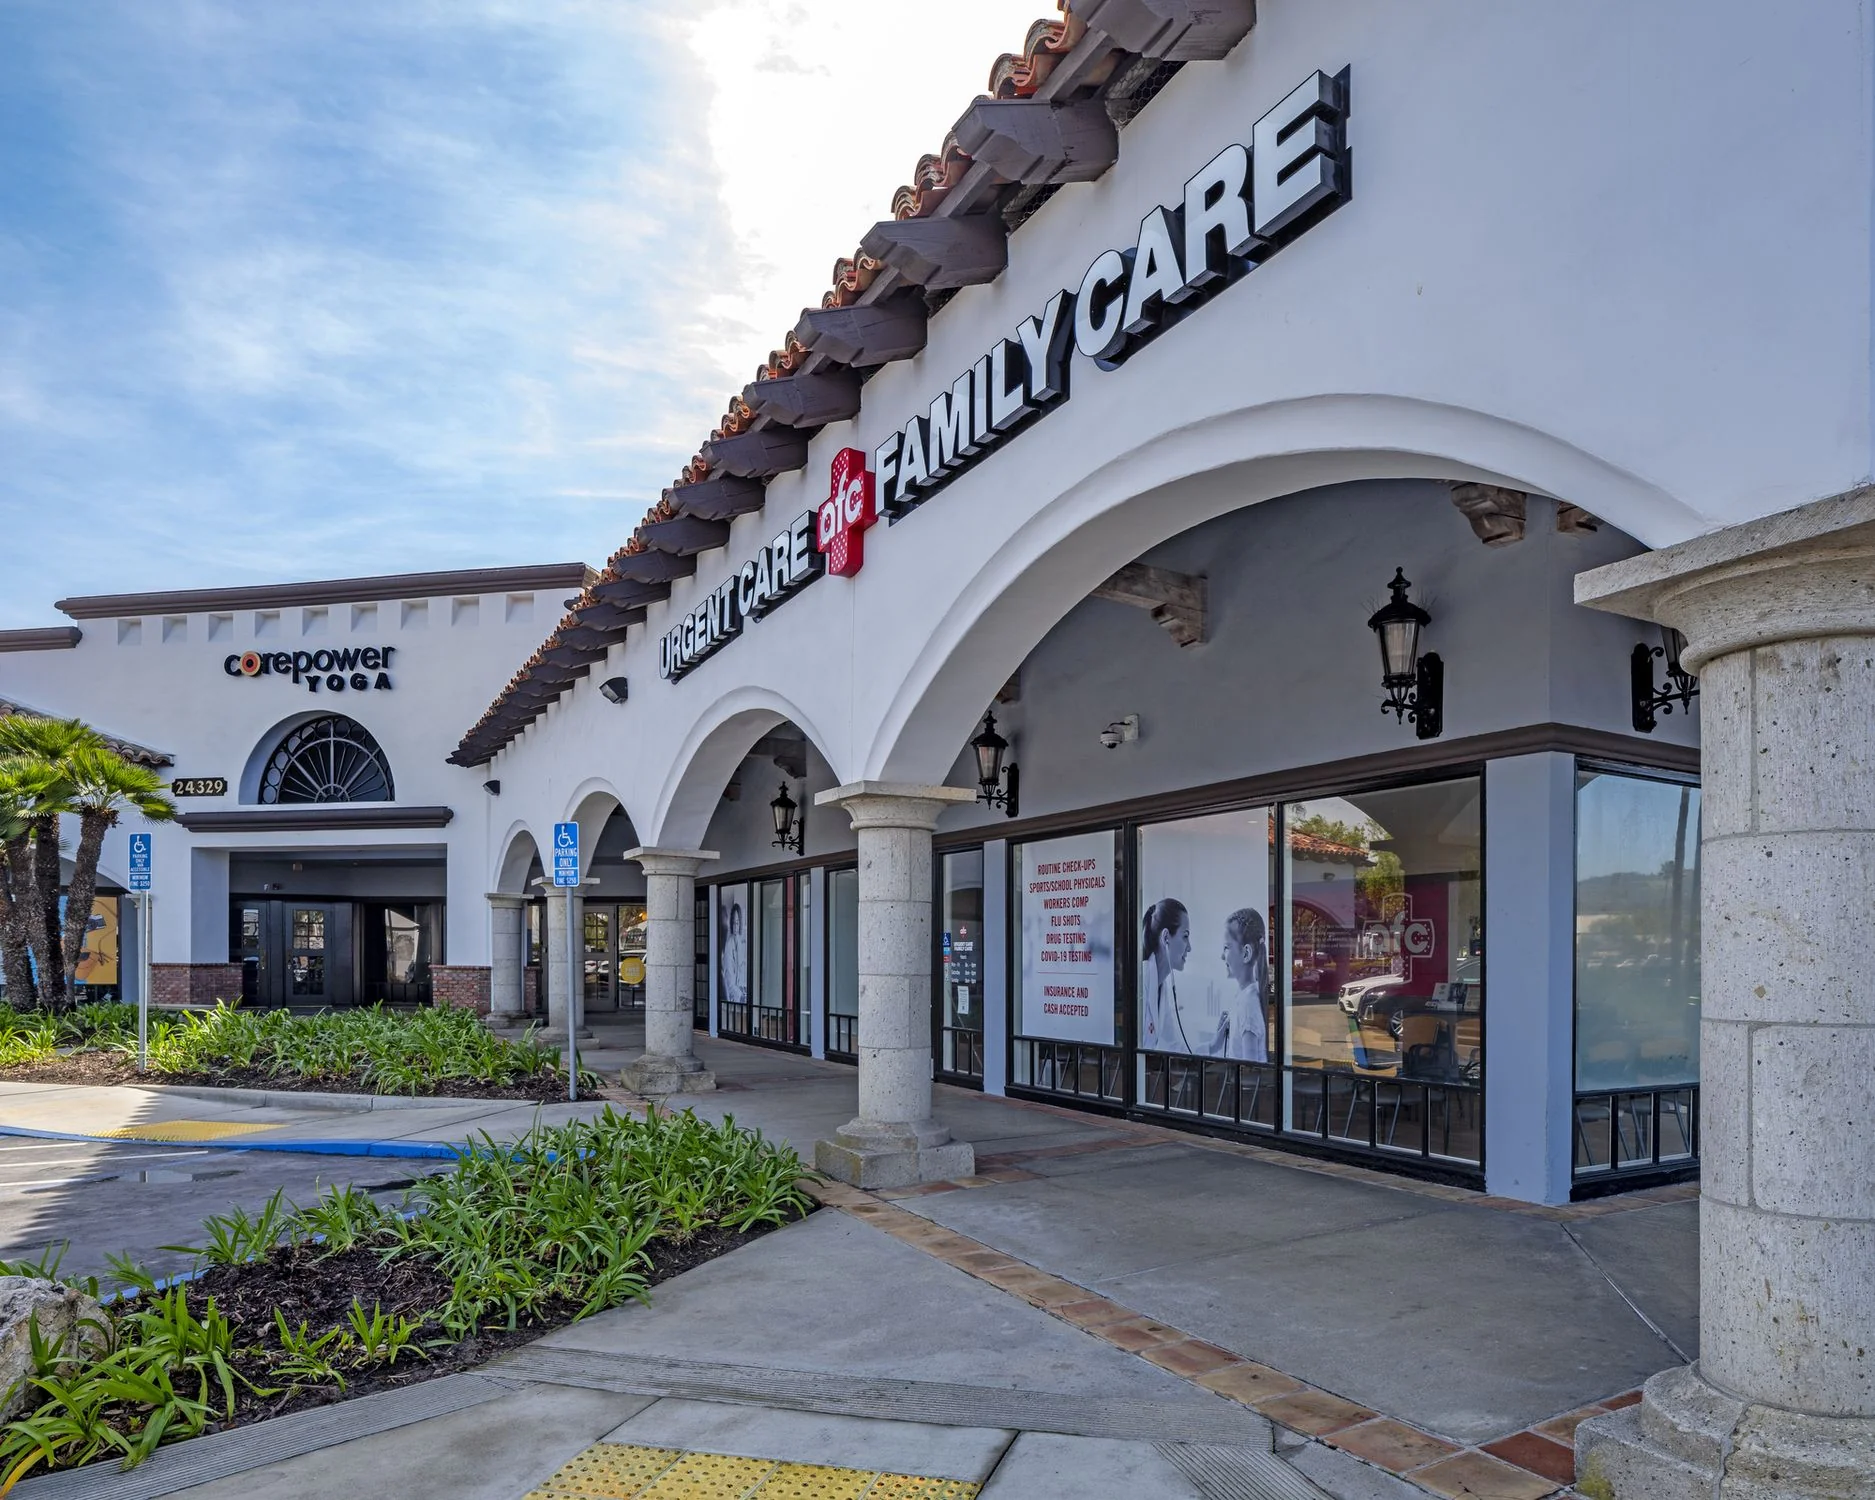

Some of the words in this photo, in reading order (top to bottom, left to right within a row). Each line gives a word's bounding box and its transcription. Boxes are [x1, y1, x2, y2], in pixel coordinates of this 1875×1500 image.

[874, 290, 1069, 519] FAMILY
[1074, 66, 1346, 366] CARE
[820, 469, 862, 545] afc
[659, 575, 739, 681] URGENT
[738, 510, 817, 617] CARE
[224, 646, 396, 684] corepower
[304, 672, 392, 692] YOGA
[175, 779, 223, 795] 24329
[555, 848, 577, 856] PARKING
[560, 858, 572, 866] ONLY
[1037, 862, 1061, 876] ROUTINE
[1062, 859, 1096, 873] CHECK-UPS
[1029, 879, 1072, 893] SPORTS/SCHOOL
[1073, 876, 1106, 890] PHYSICALS
[1043, 897, 1070, 910] WORKERS
[1071, 896, 1089, 908] COMP
[1051, 915, 1061, 926] FLU
[1062, 915, 1080, 926] SHOTS
[1046, 933, 1061, 944] DRUG
[1062, 932, 1086, 944] TESTING
[1041, 951, 1067, 962] COVID-19
[1068, 951, 1092, 962] TESTING
[1043, 985, 1075, 998] INSURANCE
[1076, 987, 1089, 999] AND
[1043, 1003, 1058, 1014] CASH
[1059, 1004, 1089, 1017] ACCEPTED
